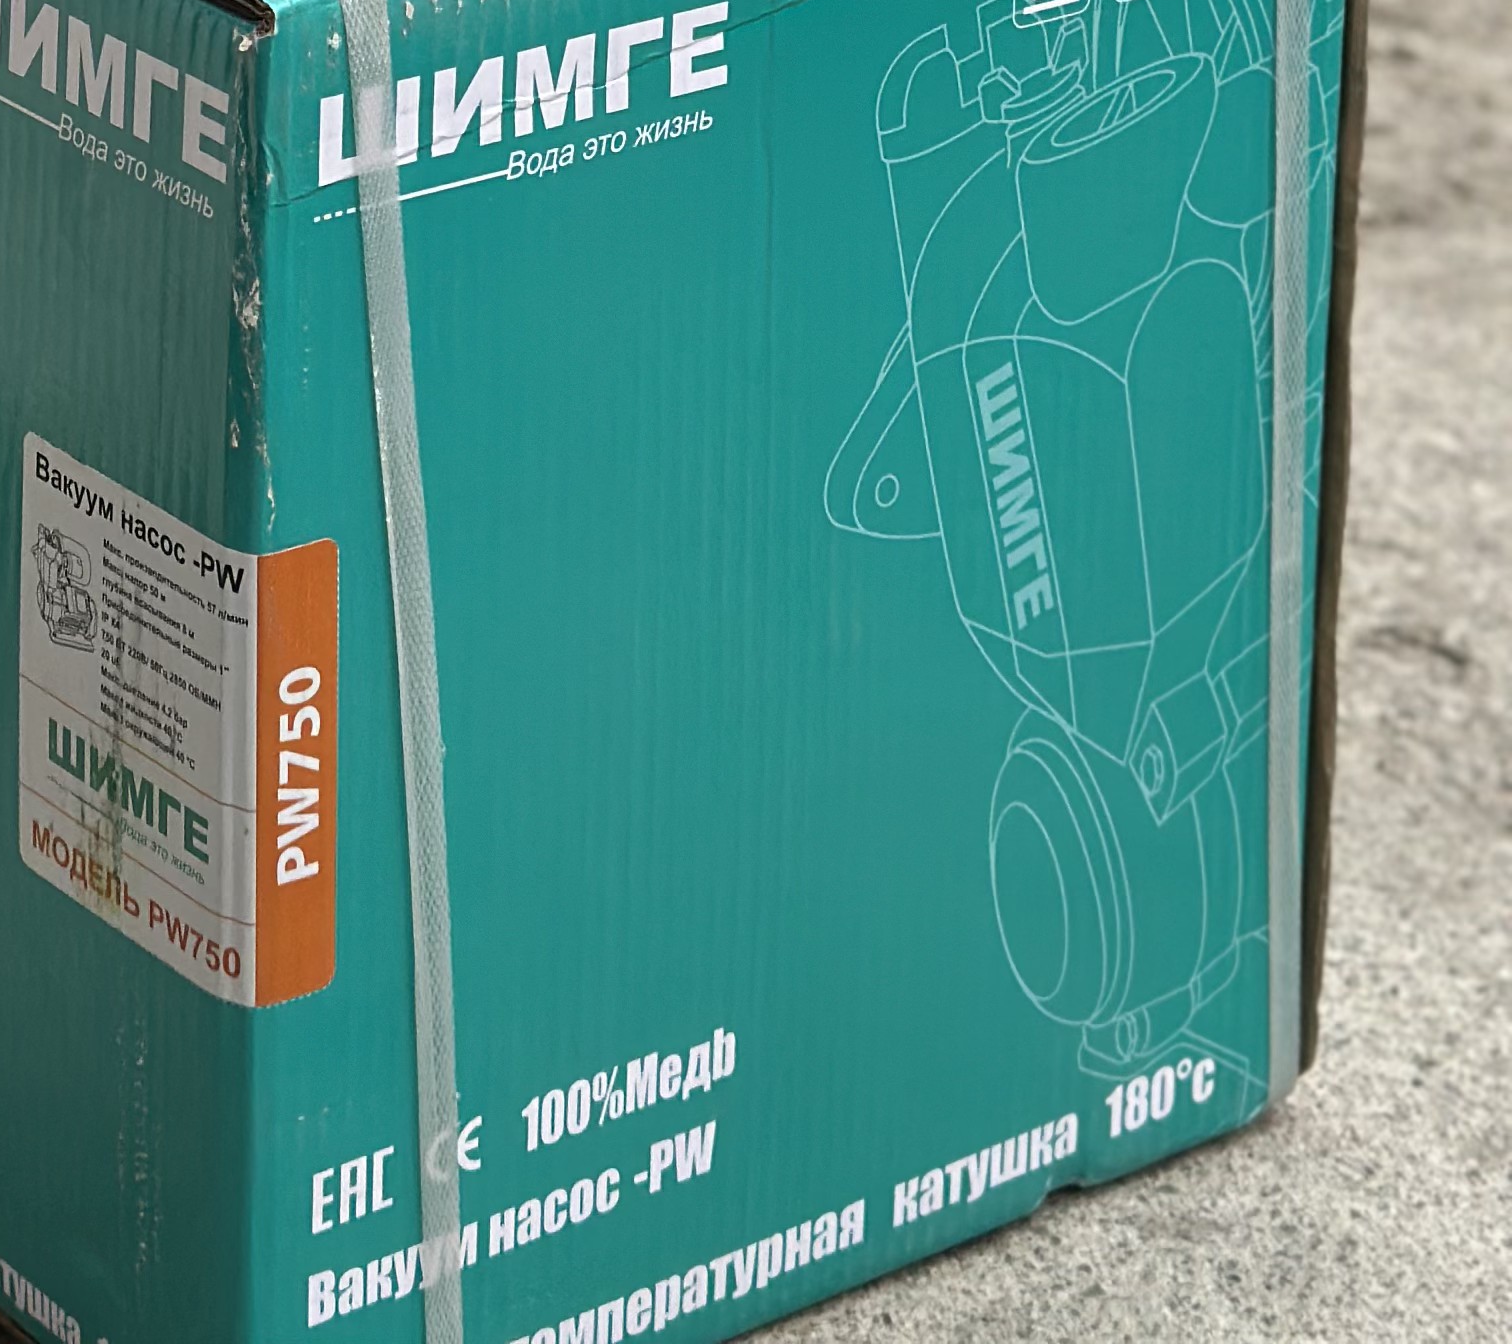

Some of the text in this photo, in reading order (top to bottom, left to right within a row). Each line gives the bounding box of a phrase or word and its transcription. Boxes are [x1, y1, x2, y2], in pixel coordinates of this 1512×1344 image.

[318, 1, 729, 187] ШИМГЕ
[505, 110, 714, 181] Вода это жизнь
[58, 112, 214, 219] Вода это жизнь
[35, 452, 114, 523] Вакуум
[120, 508, 186, 566] насос
[975, 361, 1055, 631] ШИМГЕ
[101, 611, 109, 623] IP
[102, 576, 132, 601] глубина
[134, 596, 181, 631] всасывания
[124, 570, 149, 593] напор
[150, 583, 159, 599] 50
[182, 645, 217, 672] размеры
[173, 710, 188, 729] бар
[276, 666, 321, 886] PW750
[48, 717, 210, 864] ШИМГЕ
[32, 819, 241, 979] МОДЕЛЬ PW750
[150, 840, 169, 861] это
[171, 854, 205, 886] жизнь
[521, 1027, 737, 1152] 100%Медь
[488, 1168, 620, 1259] насос
[634, 1120, 717, 1195] -PW
[893, 1113, 1080, 1228] катушка
